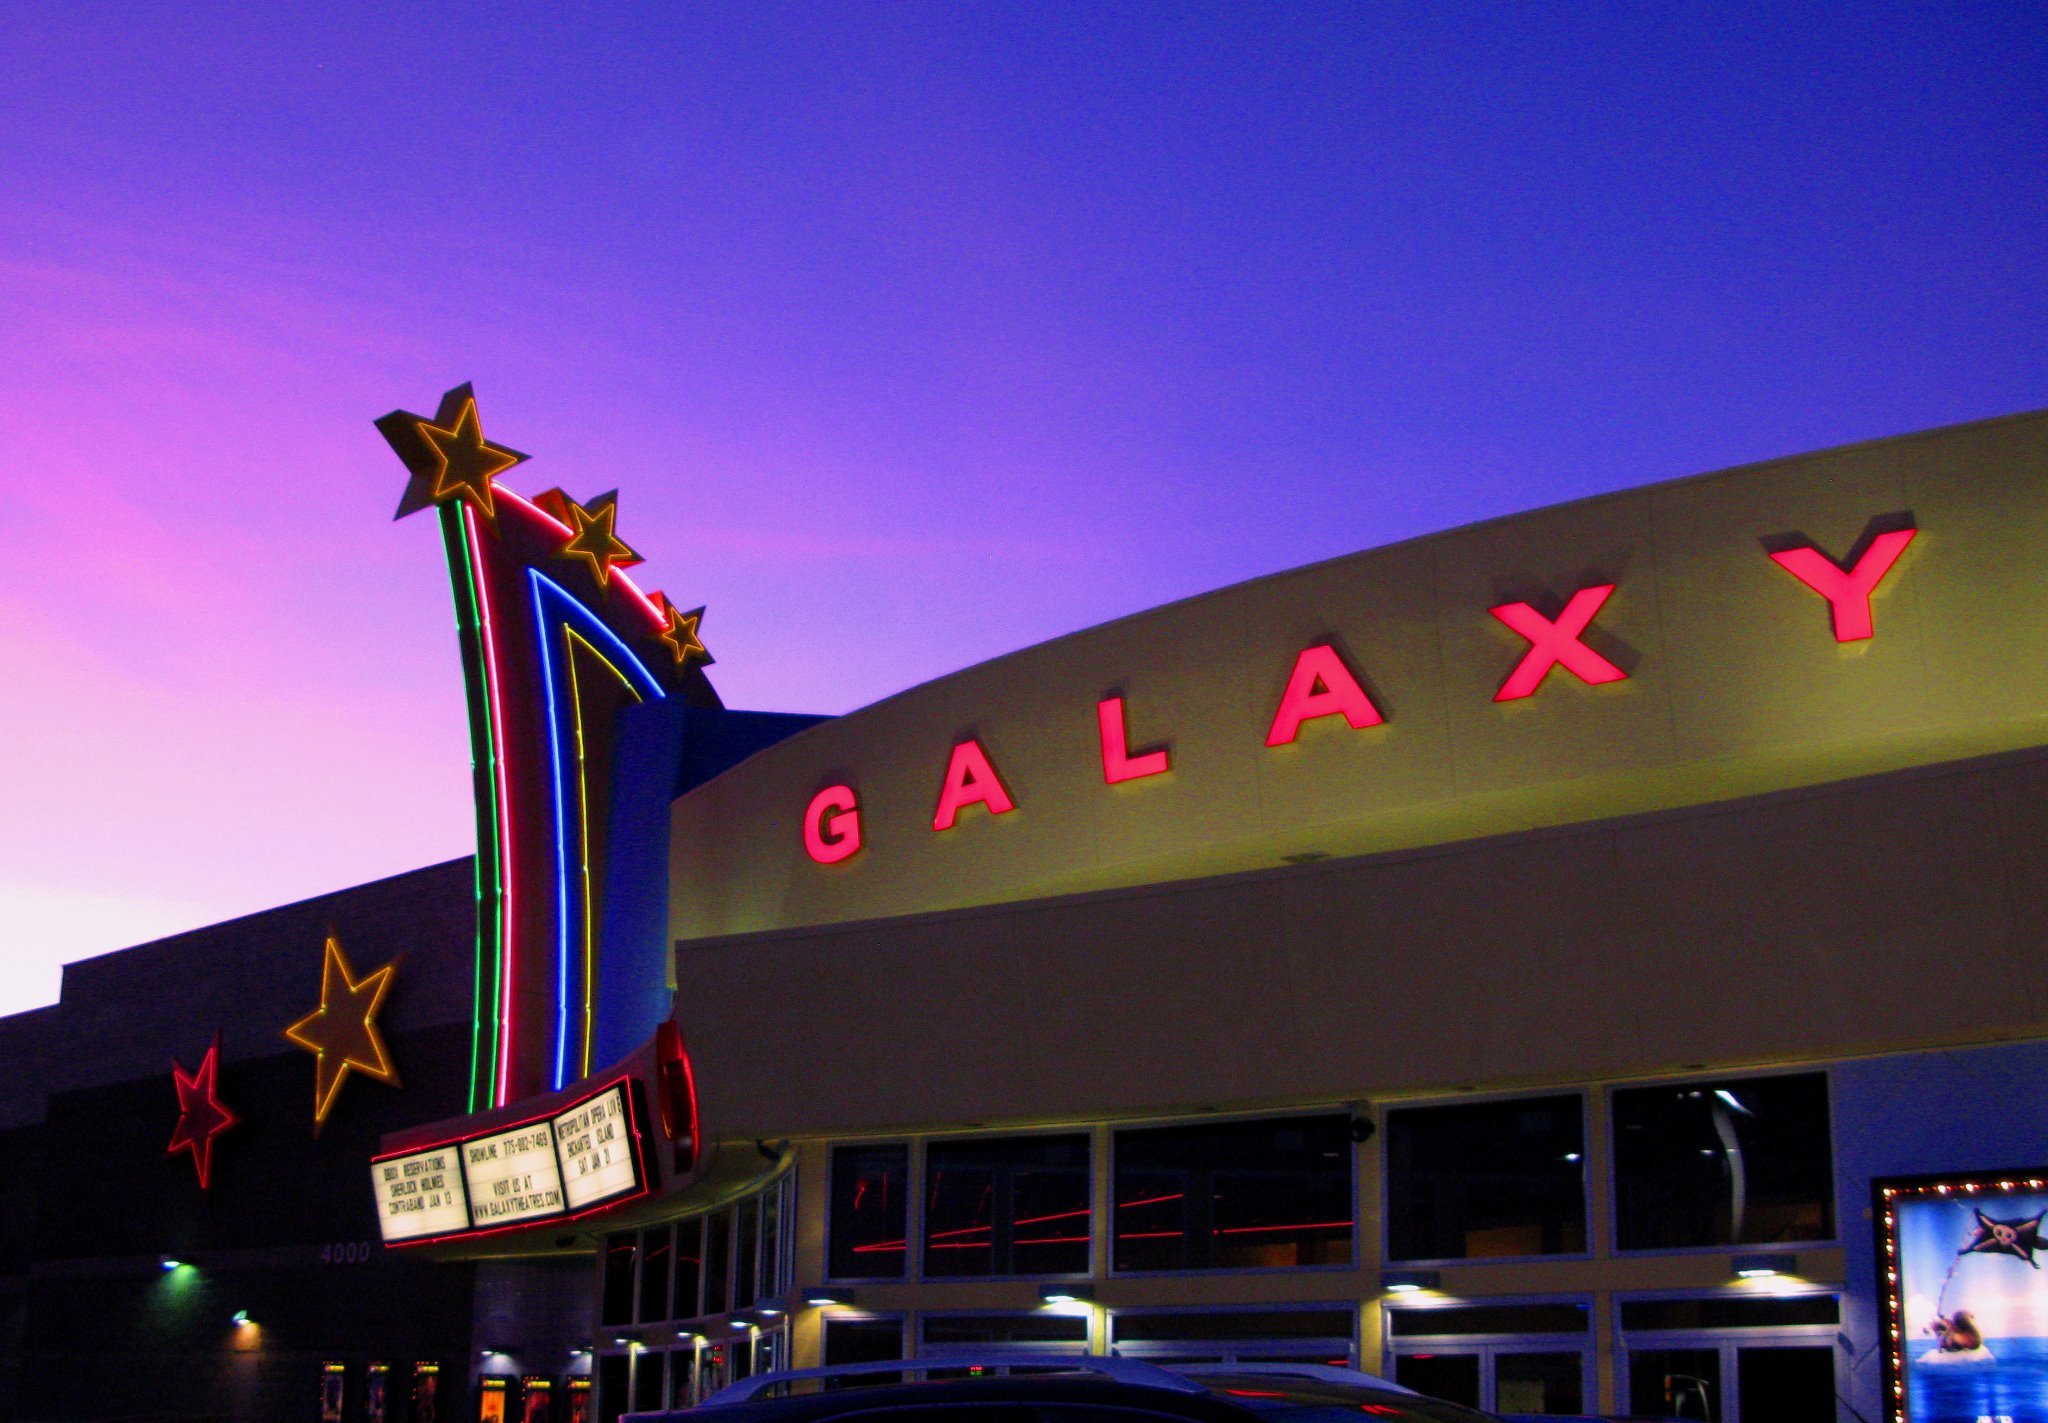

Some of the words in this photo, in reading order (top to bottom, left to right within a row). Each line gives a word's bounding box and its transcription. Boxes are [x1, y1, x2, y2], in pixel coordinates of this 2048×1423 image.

[803, 520, 1918, 865] GALAXY
[558, 1111, 590, 1140] METROPOLITAN
[590, 1104, 606, 1125] OPERA
[607, 1096, 622, 1117] LIVE
[596, 1123, 614, 1144] ISLAND
[469, 1144, 497, 1163] SHOWLINE
[578, 1157, 588, 1175] SAT
[591, 1152, 601, 1170] JAN
[604, 1148, 610, 1165] 21
[403, 1156, 446, 1177] RESERVATIONS
[391, 1181, 417, 1197] SHERLOCK
[421, 1175, 444, 1191] HOLMES
[493, 1180, 510, 1197] VISIT
[512, 1177, 521, 1193] US
[524, 1175, 532, 1191] AT
[389, 1196, 424, 1215] CONTRABAND
[430, 1193, 440, 1208] JAN
[445, 1191, 451, 1205] 13
[320, 1241, 371, 1264] 4000
